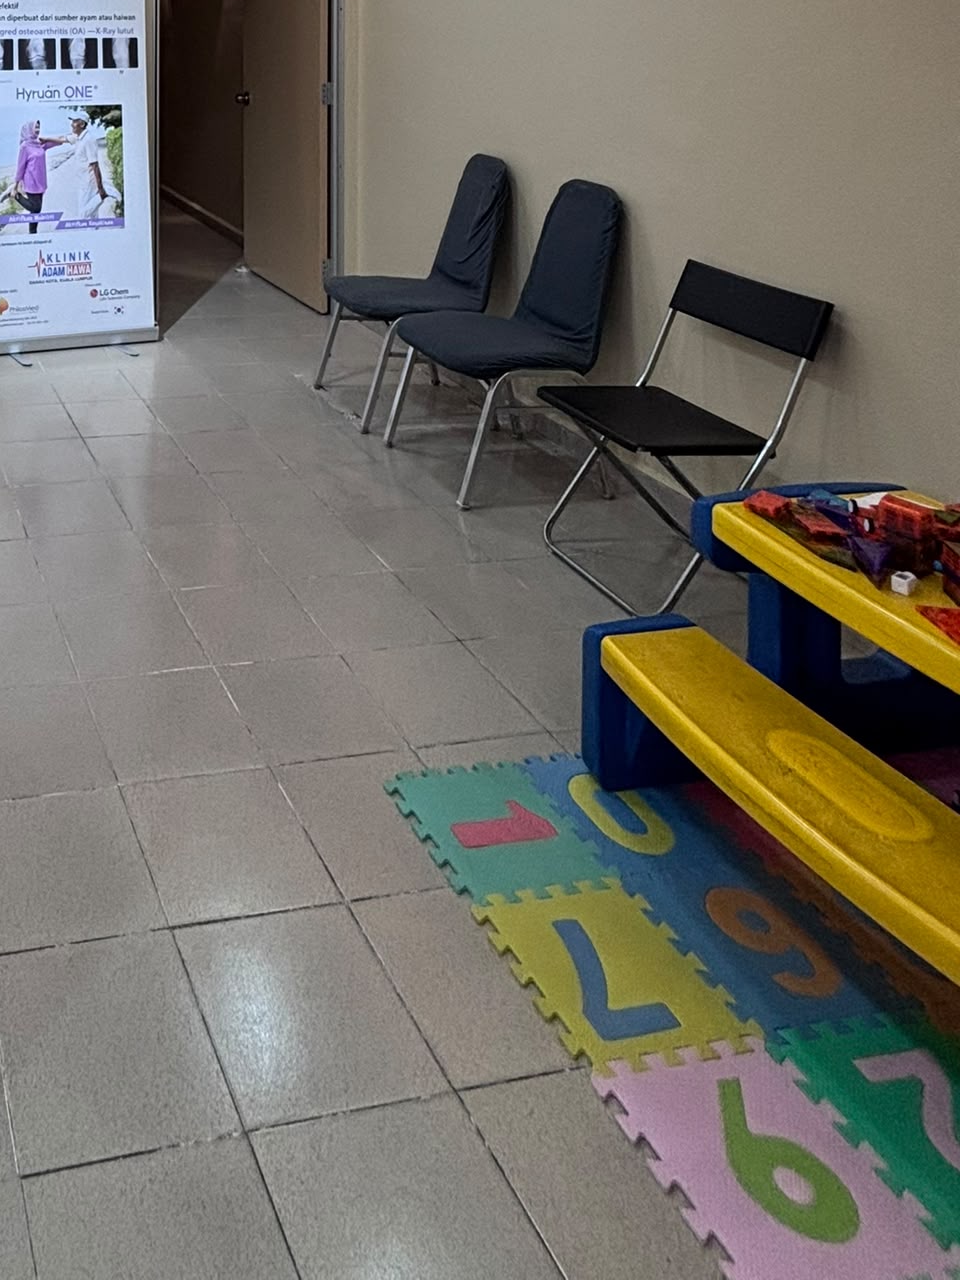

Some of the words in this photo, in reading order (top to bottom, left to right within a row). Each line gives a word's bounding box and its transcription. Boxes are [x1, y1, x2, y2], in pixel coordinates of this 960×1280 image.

[7, 14, 38, 23] diperbuat
[19, 27, 68, 36] osteoarthritis
[70, 27, 86, 36] (OA)
[46, 251, 91, 263] KLINIK
[42, 265, 65, 278] ADAM
[68, 263, 91, 276] HAWA
[450, 799, 558, 848] 1
[552, 919, 682, 1041] 7
